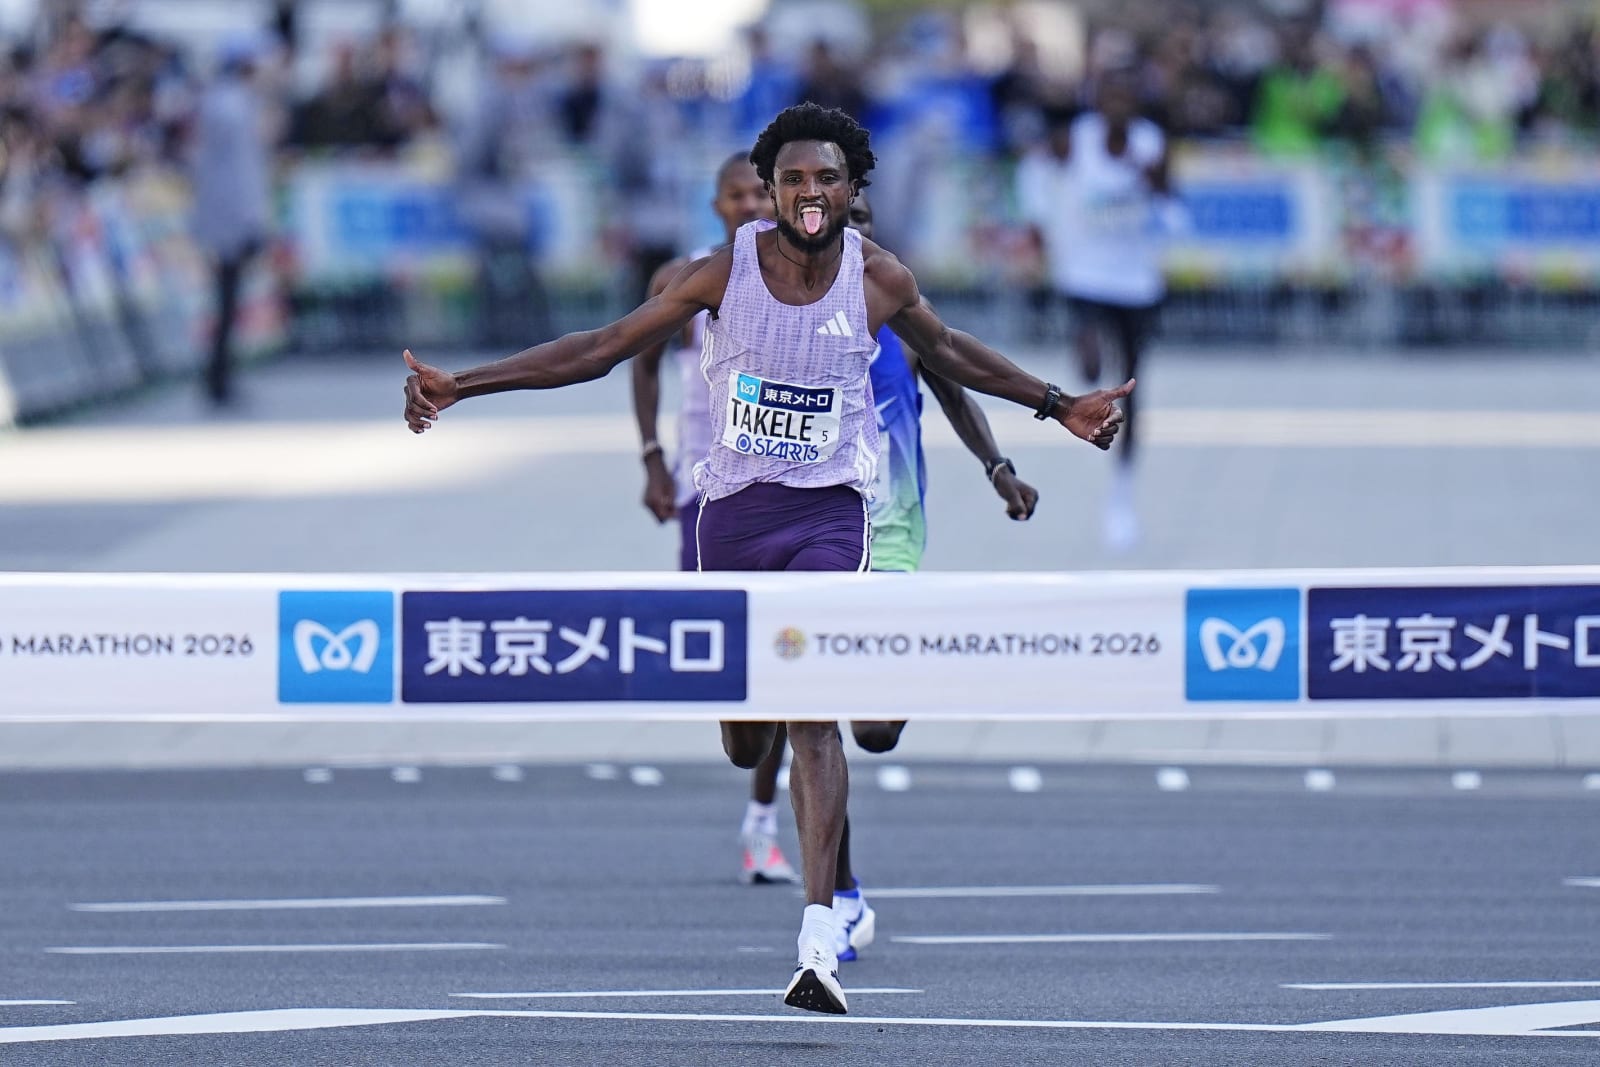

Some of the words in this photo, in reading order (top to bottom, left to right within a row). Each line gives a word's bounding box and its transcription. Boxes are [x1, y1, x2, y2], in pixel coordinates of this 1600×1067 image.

[763, 388, 829, 407] 東京メトロ
[731, 398, 815, 442] TAKELE
[821, 430, 829, 443] 5
[752, 438, 819, 462] STARTS
[11, 634, 174, 656] MARATHON
[184, 634, 254, 656] 2026
[423, 617, 725, 677] 東京メトロ
[815, 633, 911, 656] TOKYO
[919, 633, 1081, 656] MARATHON
[1089, 632, 1162, 656] 2026
